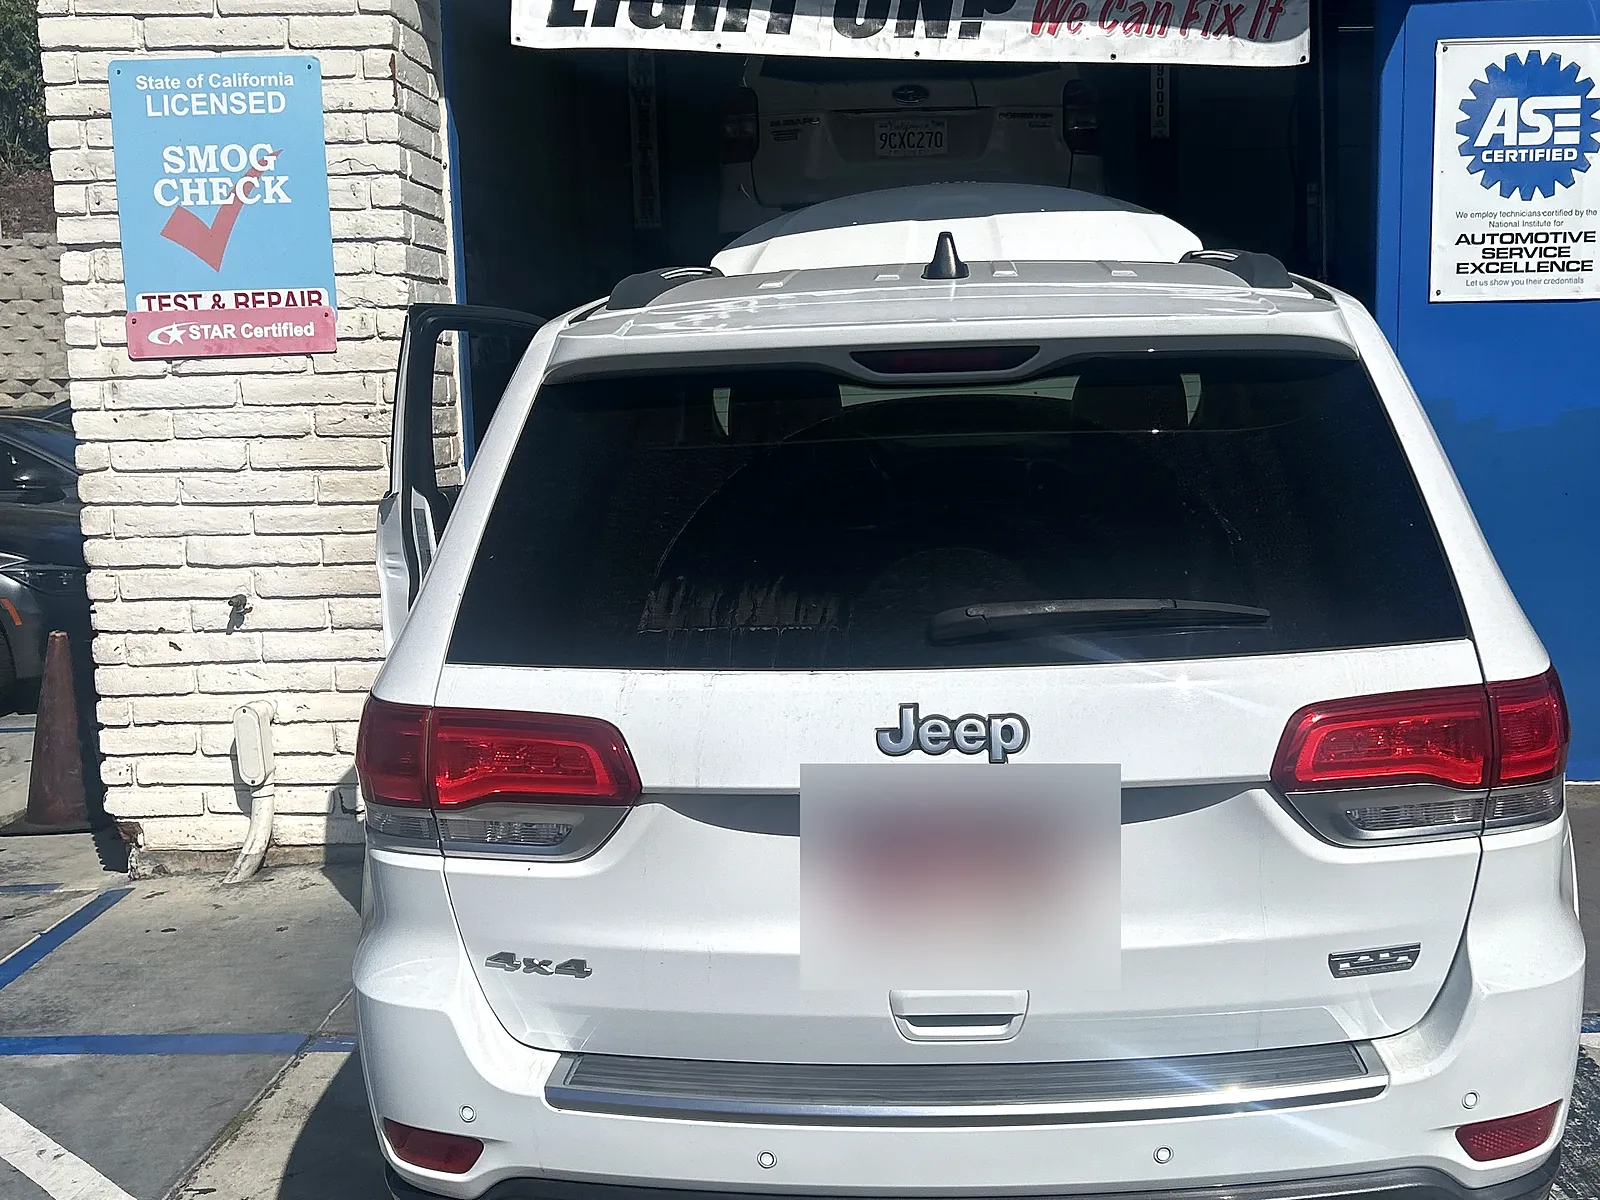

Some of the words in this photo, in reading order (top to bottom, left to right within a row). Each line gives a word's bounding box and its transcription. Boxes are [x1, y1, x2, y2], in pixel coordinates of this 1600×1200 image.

[1030, 0, 1087, 36] We
[1099, 0, 1169, 37] Can
[1180, 0, 1244, 38] Fix
[1248, 0, 1285, 39] It
[136, 74, 181, 90] State
[186, 73, 204, 89] of
[208, 71, 295, 88] California
[145, 91, 286, 117] LICENSED
[1473, 95, 1582, 147] ASE
[879, 131, 943, 149] 9CXC270
[163, 143, 277, 174] SMOG
[1481, 148, 1578, 163] CERTIFIED
[153, 175, 292, 207] CHECK
[1455, 211, 1468, 219] We
[1470, 211, 1498, 220] employ
[1500, 209, 1541, 218] technicians
[1542, 208, 1573, 217] certified
[1574, 208, 1585, 219] by
[1585, 208, 1598, 216] the
[1488, 220, 1520, 228] National
[1522, 219, 1551, 227] Institute
[1553, 219, 1564, 227] for
[1455, 231, 1596, 245] AUTOMOTIVE
[1482, 246, 1571, 259] SERVICE
[1456, 260, 1593, 274] EXCELLENCE
[1465, 279, 1477, 287] Let
[1489, 279, 1510, 287] show
[1510, 279, 1525, 287] you
[1543, 276, 1584, 285] credentials
[142, 293, 202, 311] TEST
[211, 293, 226, 310] &
[234, 290, 323, 309] REPAIR
[188, 323, 237, 340] STAR
[240, 322, 315, 338] Certified
[875, 702, 1031, 764] Jeep
[485, 951, 592, 978] 4x4
